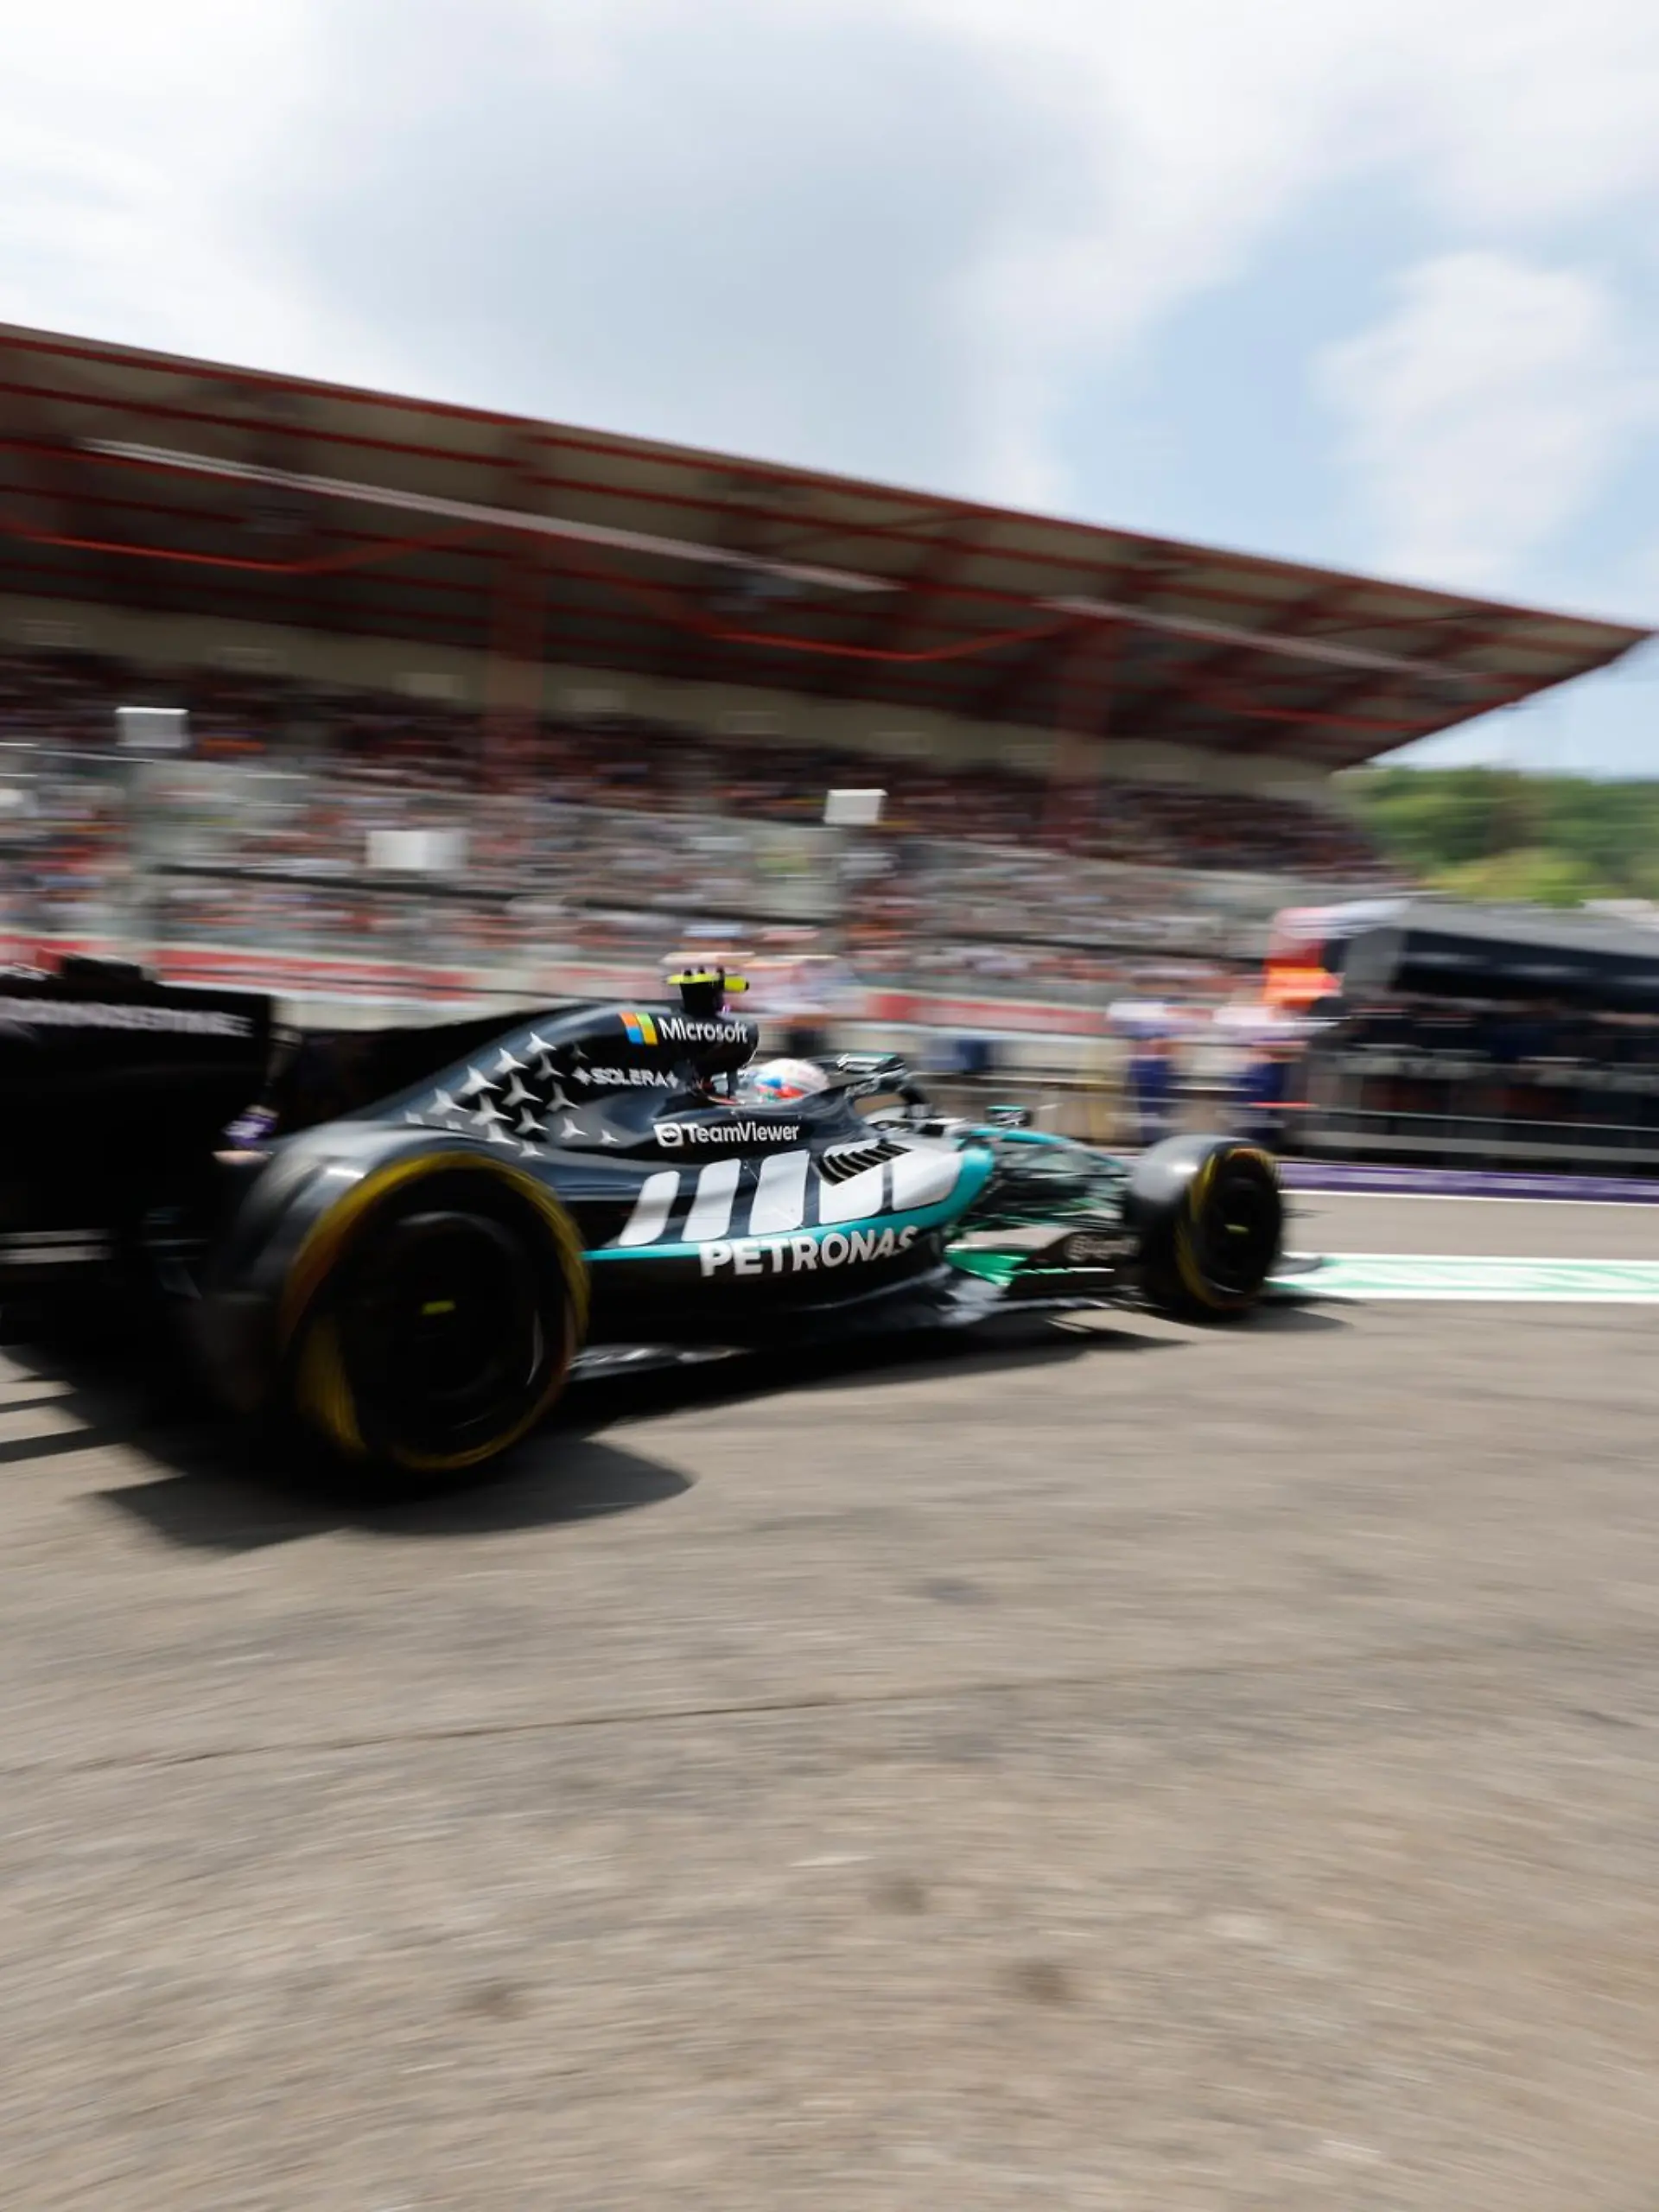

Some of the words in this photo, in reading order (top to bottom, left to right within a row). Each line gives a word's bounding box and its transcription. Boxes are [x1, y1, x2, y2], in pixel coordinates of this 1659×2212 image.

[658, 1016, 747, 1044] Microsoft
[591, 1067, 669, 1089] SOLERA
[680, 1121, 800, 1143] TeamViewer
[698, 1225, 918, 1277] PETRONAS
